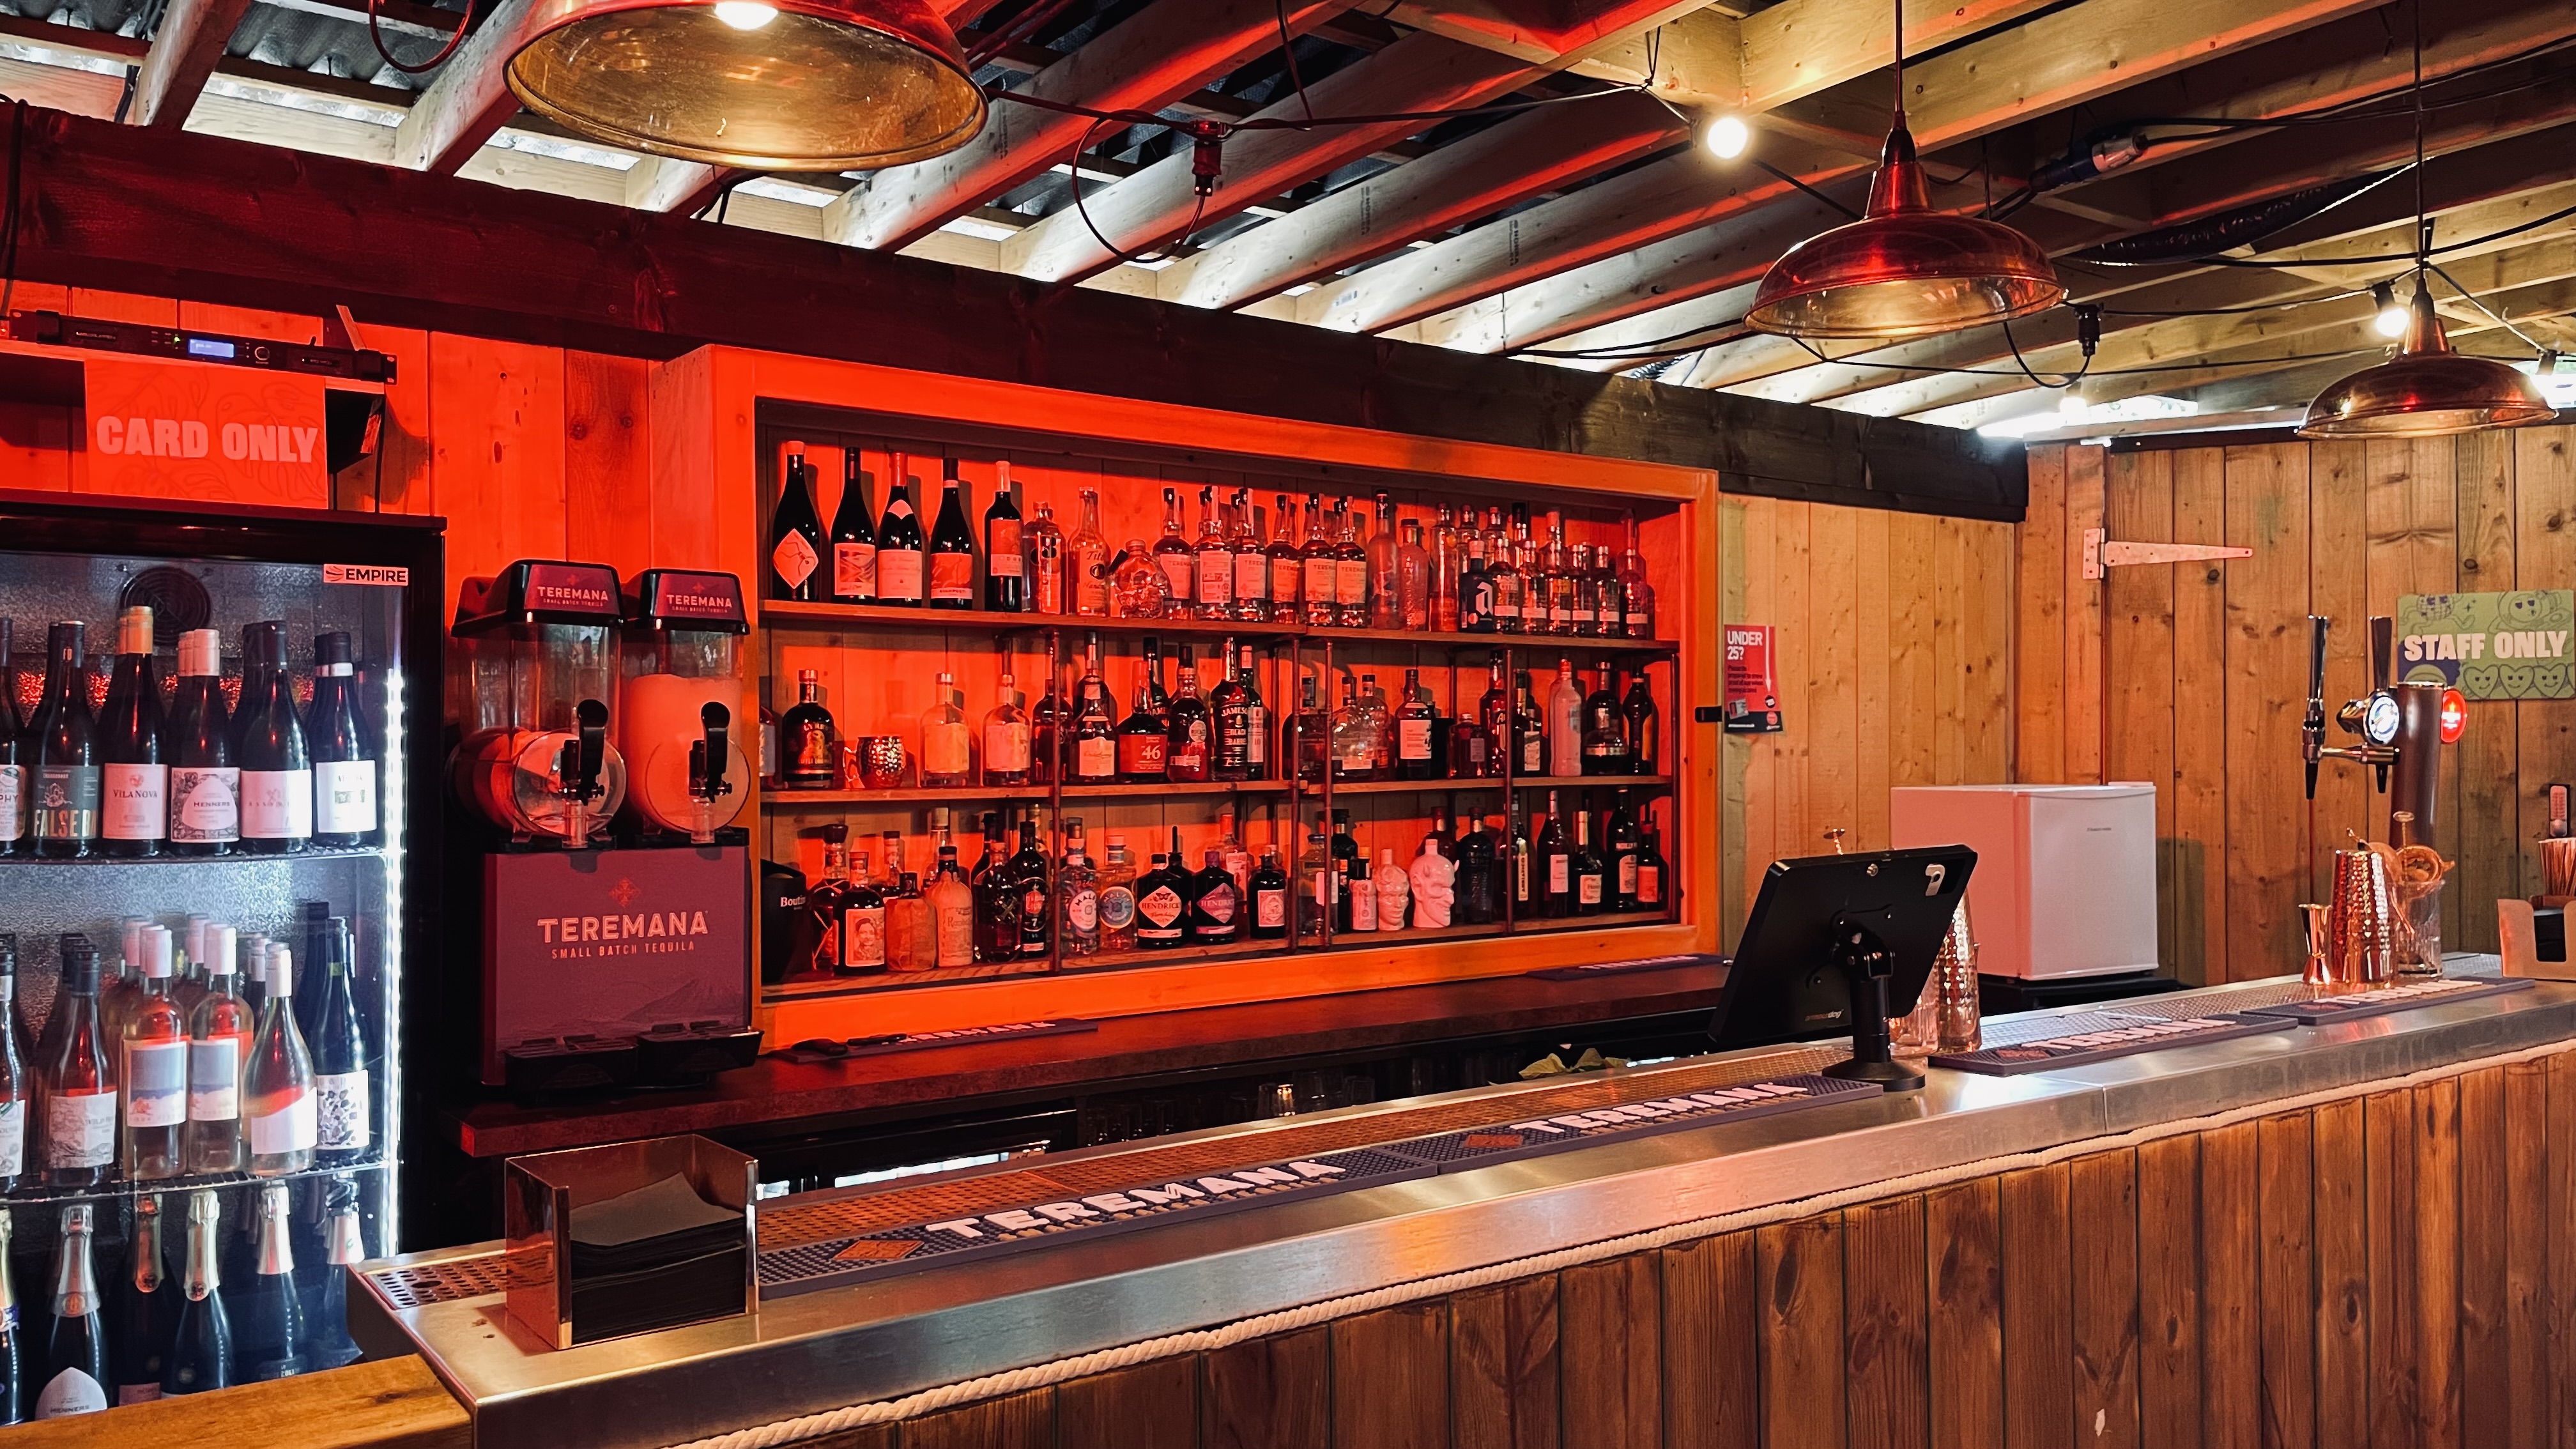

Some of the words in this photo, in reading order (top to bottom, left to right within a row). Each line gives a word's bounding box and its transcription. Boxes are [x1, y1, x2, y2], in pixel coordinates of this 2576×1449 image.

[96, 416, 209, 458] CARD
[222, 422, 318, 463] ONLY
[345, 567, 406, 583] EMPIRE
[537, 586, 609, 601] TEREMANA
[666, 594, 732, 608] TEREMANA
[1727, 631, 1763, 646] UNDER
[2404, 633, 2486, 661] STAFF
[2494, 631, 2567, 659] ONLY
[1727, 646, 1744, 660] 25?
[1142, 744, 1162, 760] 46
[34, 809, 79, 838] FALSE
[537, 910, 708, 944] TEREMANA
[551, 947, 593, 960] SMALL
[599, 943, 638, 957] BATCH
[645, 940, 695, 954] TEQUILA
[1510, 1082, 1808, 1133] TEREMANA
[925, 1158, 1346, 1239] TEREMANA
